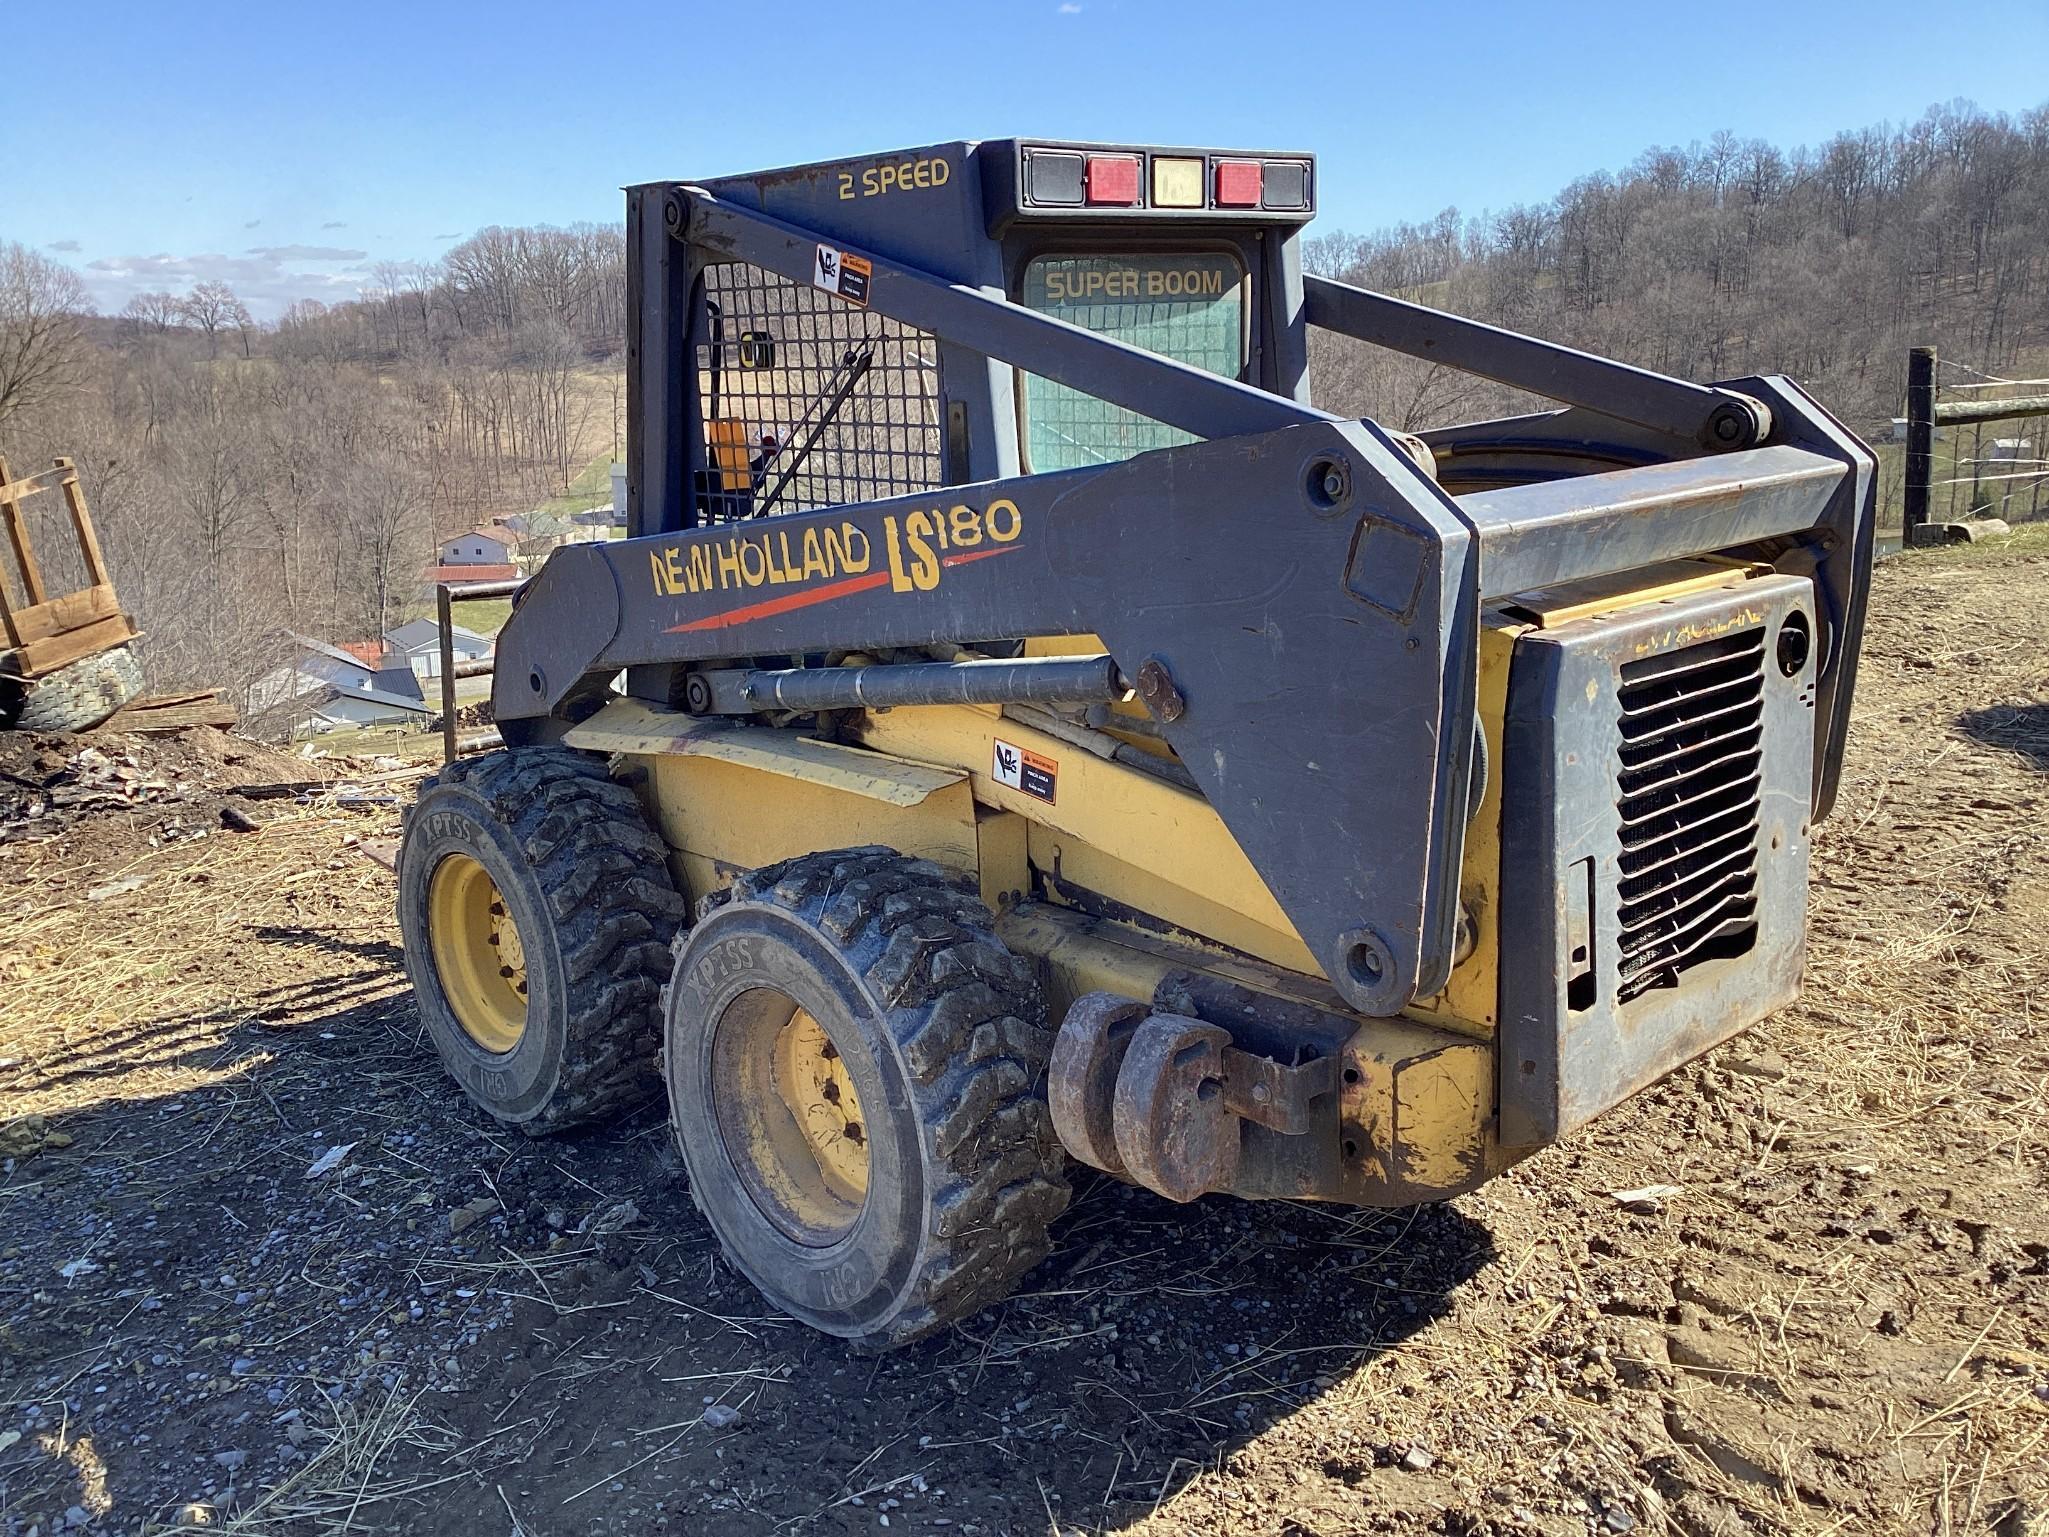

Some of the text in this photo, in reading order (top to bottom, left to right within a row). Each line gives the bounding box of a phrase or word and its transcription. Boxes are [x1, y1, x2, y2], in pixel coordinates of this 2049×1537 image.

[838, 158, 950, 200] 2 SPEED
[1045, 269, 1223, 299] SUPER BOOM
[649, 543, 713, 597] NEW
[716, 521, 870, 590] HOLLAND
